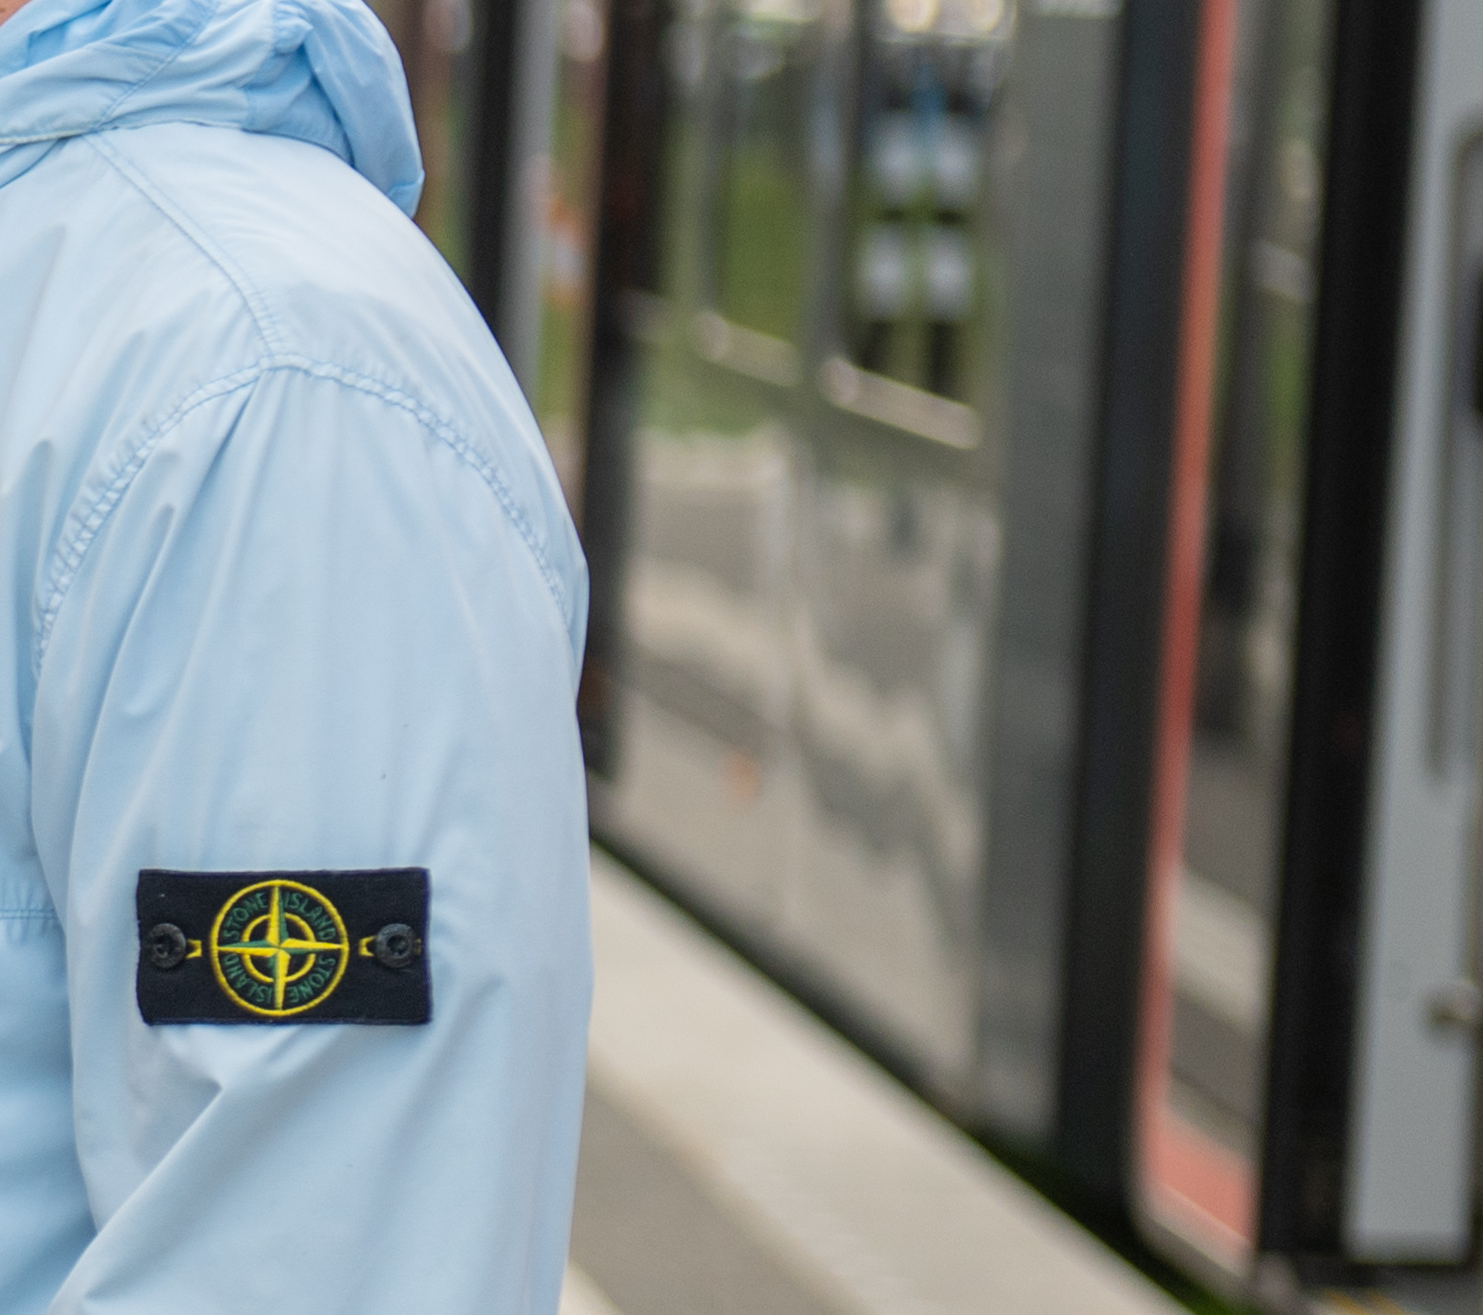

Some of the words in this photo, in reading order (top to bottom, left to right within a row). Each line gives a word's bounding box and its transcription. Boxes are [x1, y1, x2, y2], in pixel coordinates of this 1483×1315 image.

[222, 891, 268, 942] STONE
[283, 891, 336, 941] ISLAND
[223, 952, 273, 1004] ISLAND
[286, 955, 336, 1003] STONE
